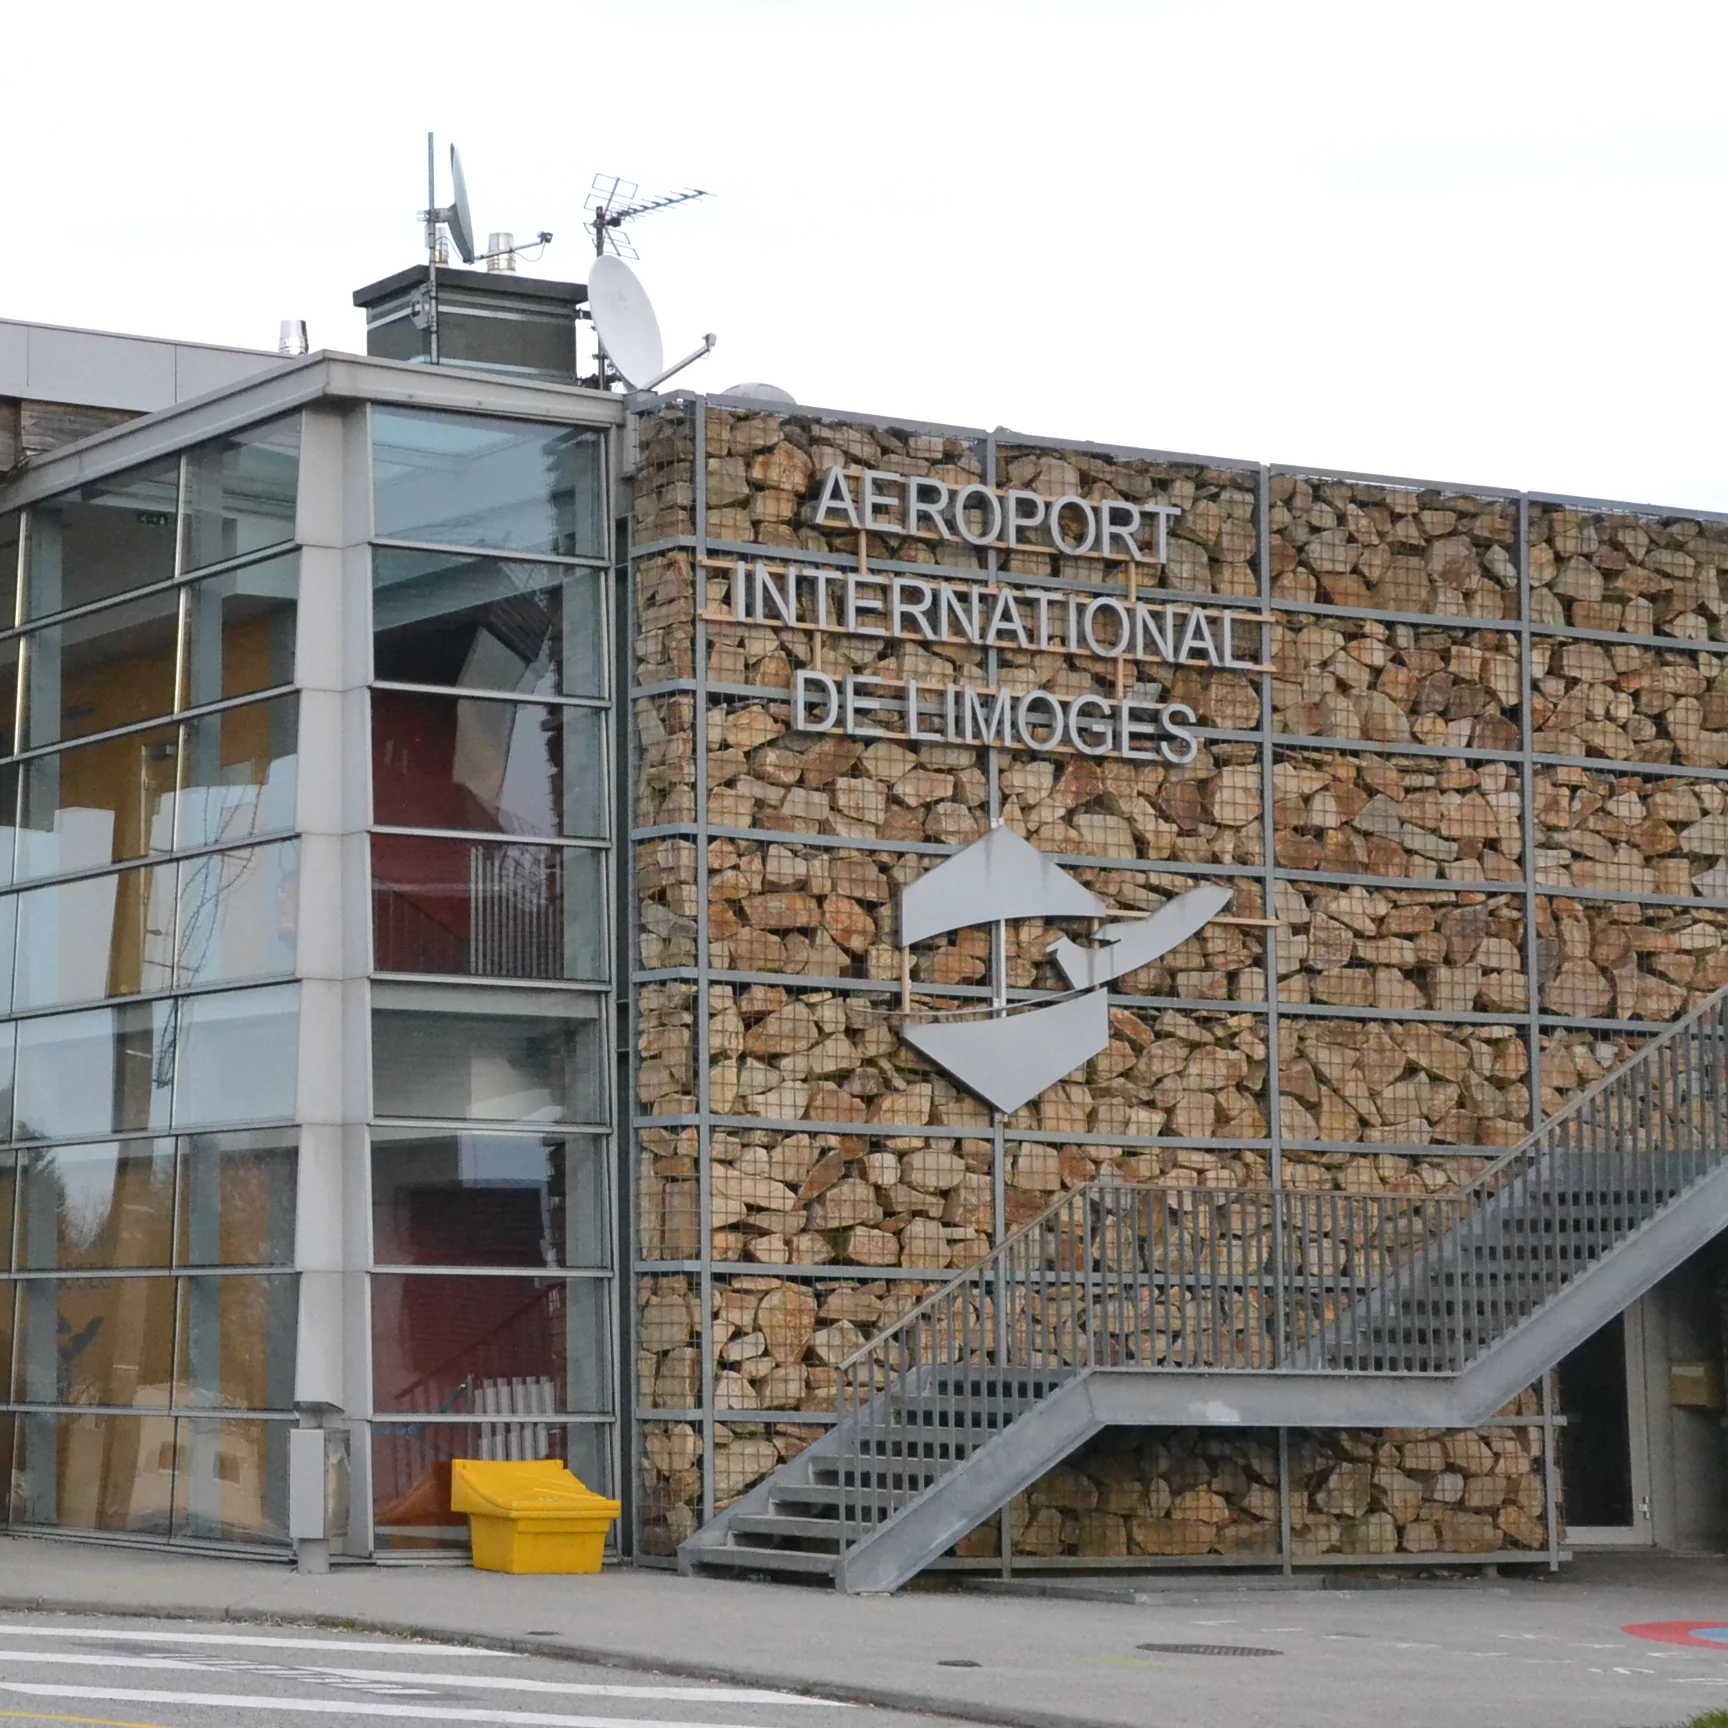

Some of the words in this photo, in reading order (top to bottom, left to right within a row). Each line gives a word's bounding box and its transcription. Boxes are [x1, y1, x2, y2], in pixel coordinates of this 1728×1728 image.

[815, 466, 1181, 564] AEROPORT
[736, 560, 1253, 670] INTERNATIONAL
[796, 670, 881, 737] DE
[909, 679, 1198, 764] LIMOGES
